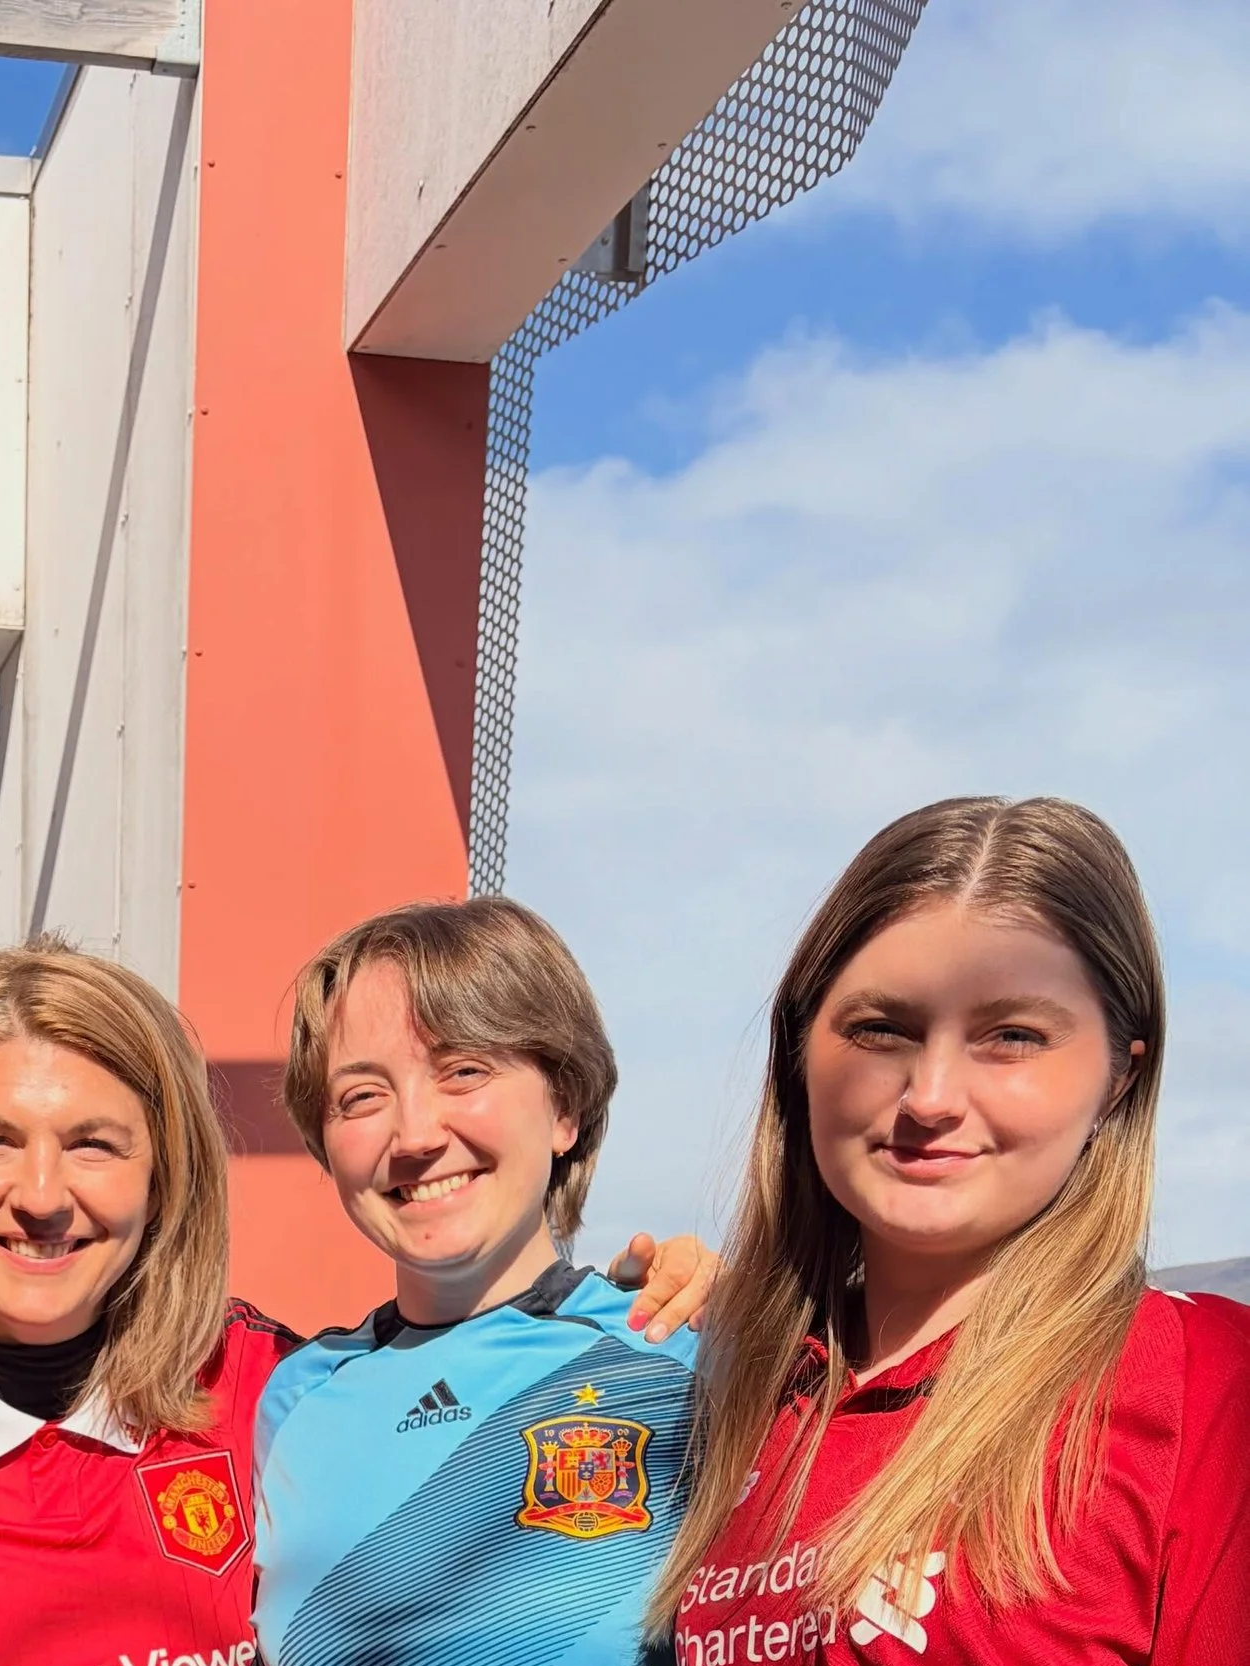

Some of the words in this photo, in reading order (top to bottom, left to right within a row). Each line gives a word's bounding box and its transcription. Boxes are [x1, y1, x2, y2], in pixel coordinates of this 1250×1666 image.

[396, 1406, 472, 1433] adidas
[164, 1475, 226, 1509] MANCHESTER
[189, 1531, 228, 1549] UNITED
